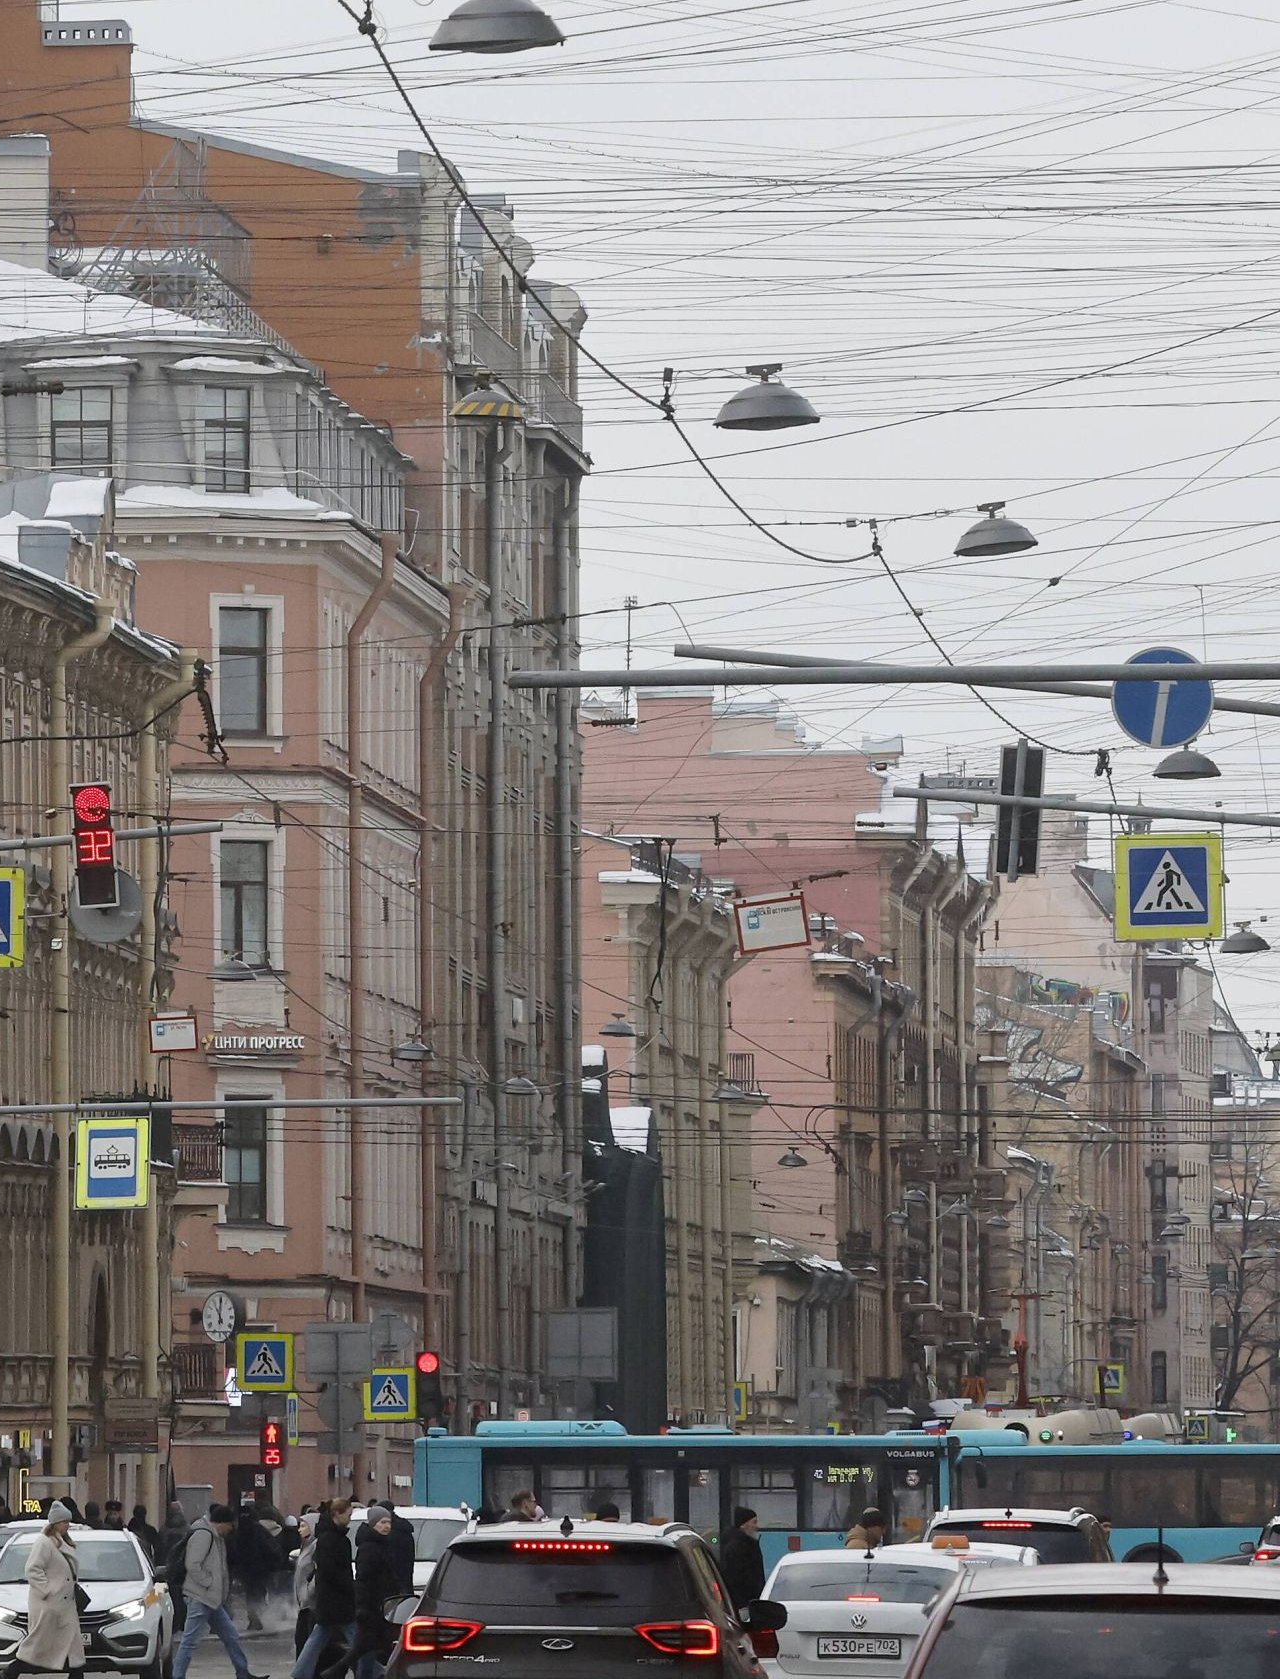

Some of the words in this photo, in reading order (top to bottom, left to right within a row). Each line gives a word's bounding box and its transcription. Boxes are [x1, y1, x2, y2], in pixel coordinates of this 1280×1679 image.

[79, 831, 111, 862] 32
[250, 1036, 305, 1049] ПРОГРЕСС
[887, 1450, 935, 1458] VOLGABUS
